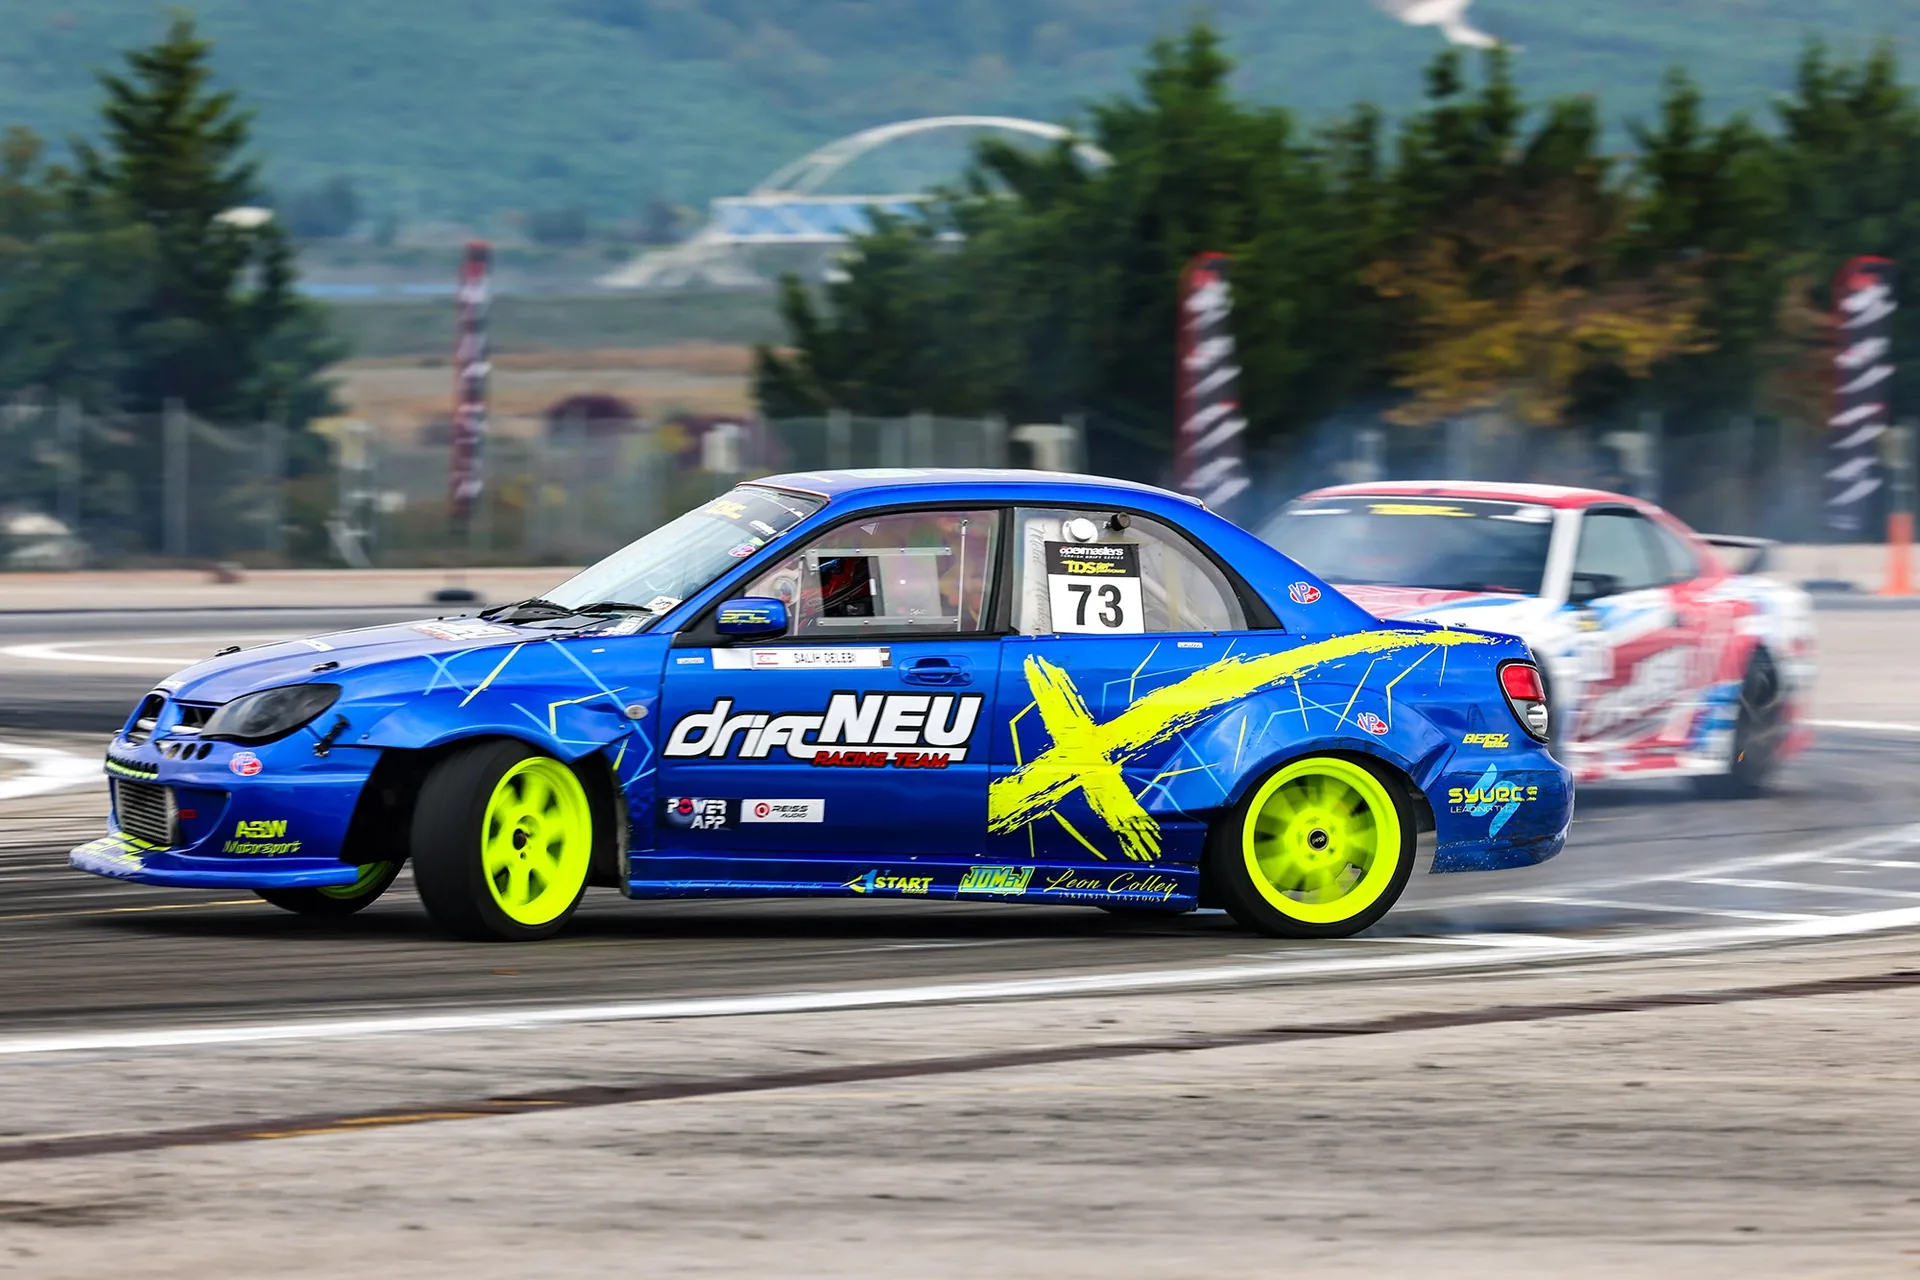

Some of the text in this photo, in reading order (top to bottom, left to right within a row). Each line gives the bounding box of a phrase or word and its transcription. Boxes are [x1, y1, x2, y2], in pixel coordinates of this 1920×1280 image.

[1067, 583, 1124, 629] 73
[812, 751, 949, 768] RACING TEAM
[667, 797, 727, 815] POWER
[771, 804, 809, 813] REISS
[690, 814, 726, 830] APP
[1043, 869, 1178, 902] Leon Colley
